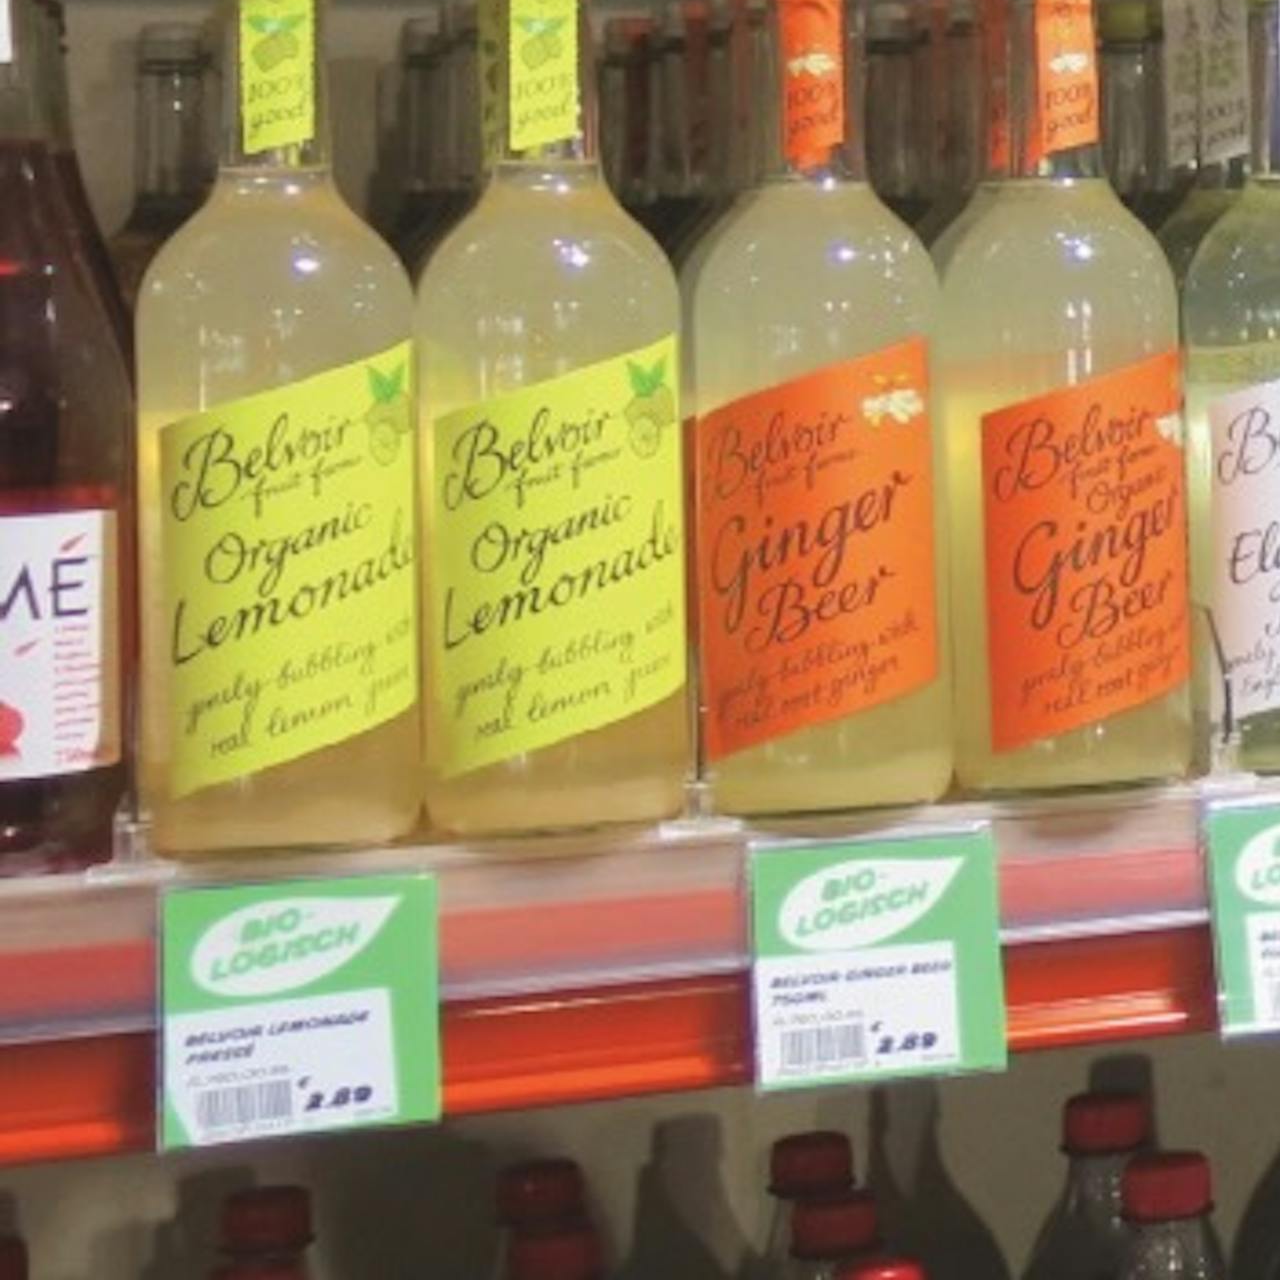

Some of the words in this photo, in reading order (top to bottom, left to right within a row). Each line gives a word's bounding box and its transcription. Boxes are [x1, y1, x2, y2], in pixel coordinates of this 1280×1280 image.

[171, 412, 352, 524] Belvoir
[443, 407, 611, 512] Belvoir
[708, 410, 848, 501] Belvoir
[993, 403, 1150, 502] Belvoir
[204, 502, 374, 598] Organic
[443, 499, 678, 651] Lemonade
[470, 493, 632, 587] Organic
[709, 469, 913, 635] Ginger
[1013, 487, 1179, 631] Ginger
[744, 565, 897, 654] Beer
[1056, 569, 1173, 650] Beer
[210, 922, 361, 981] LOGISCH
[794, 880, 931, 938] LOGISCH
[876, 1032, 938, 1055] 2.89
[304, 1085, 373, 1113] 2.89
